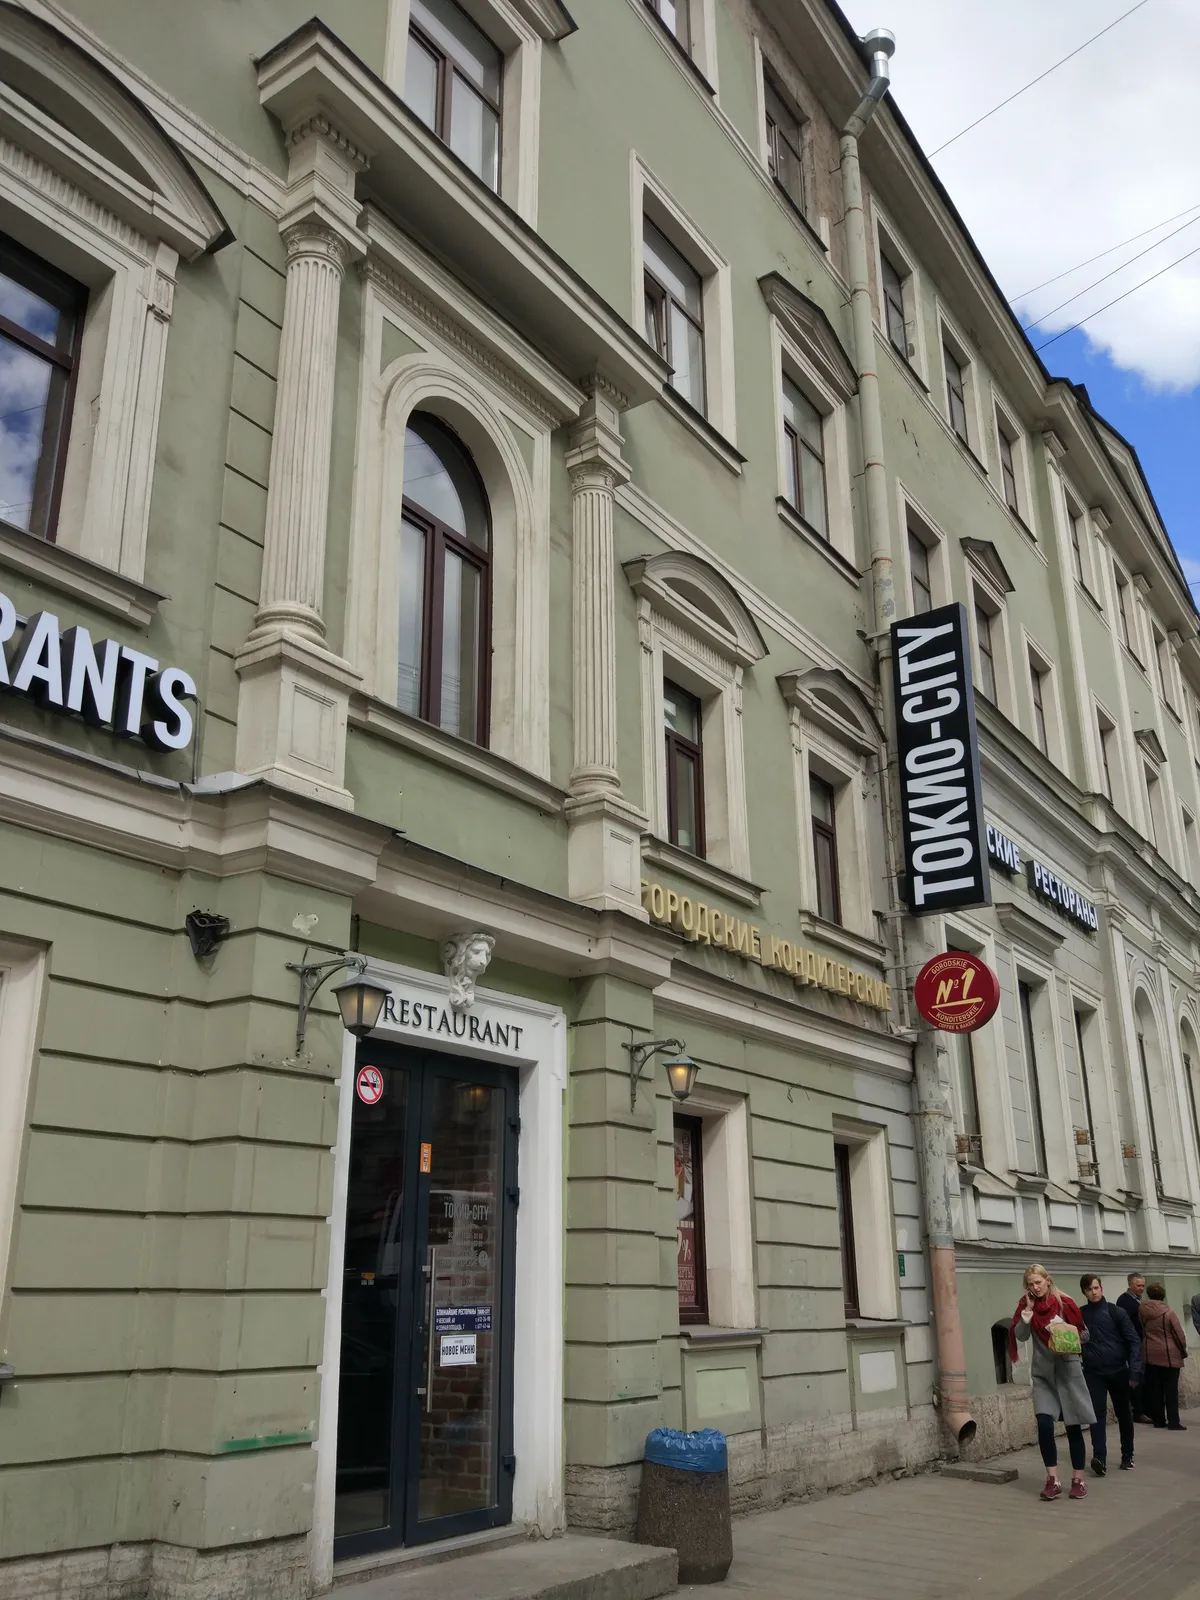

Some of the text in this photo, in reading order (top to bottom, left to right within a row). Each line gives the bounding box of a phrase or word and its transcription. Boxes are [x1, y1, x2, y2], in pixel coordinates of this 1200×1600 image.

[896, 621, 976, 906] ТОКИО-CITY
[1033, 860, 1099, 931] РЕСТОРАНЫ
[763, 934, 892, 1012] КОНДИТЕРСКИЕ
[931, 959, 968, 975] GORODSKIE
[383, 995, 523, 1050] RESTAURANT
[936, 1005, 979, 1023] KONDITERSKIE
[938, 1022, 955, 1031] COFFEE
[960, 1018, 977, 1030] BAKERY
[442, 1344, 476, 1356] НОВОЕ МЕНЮ
